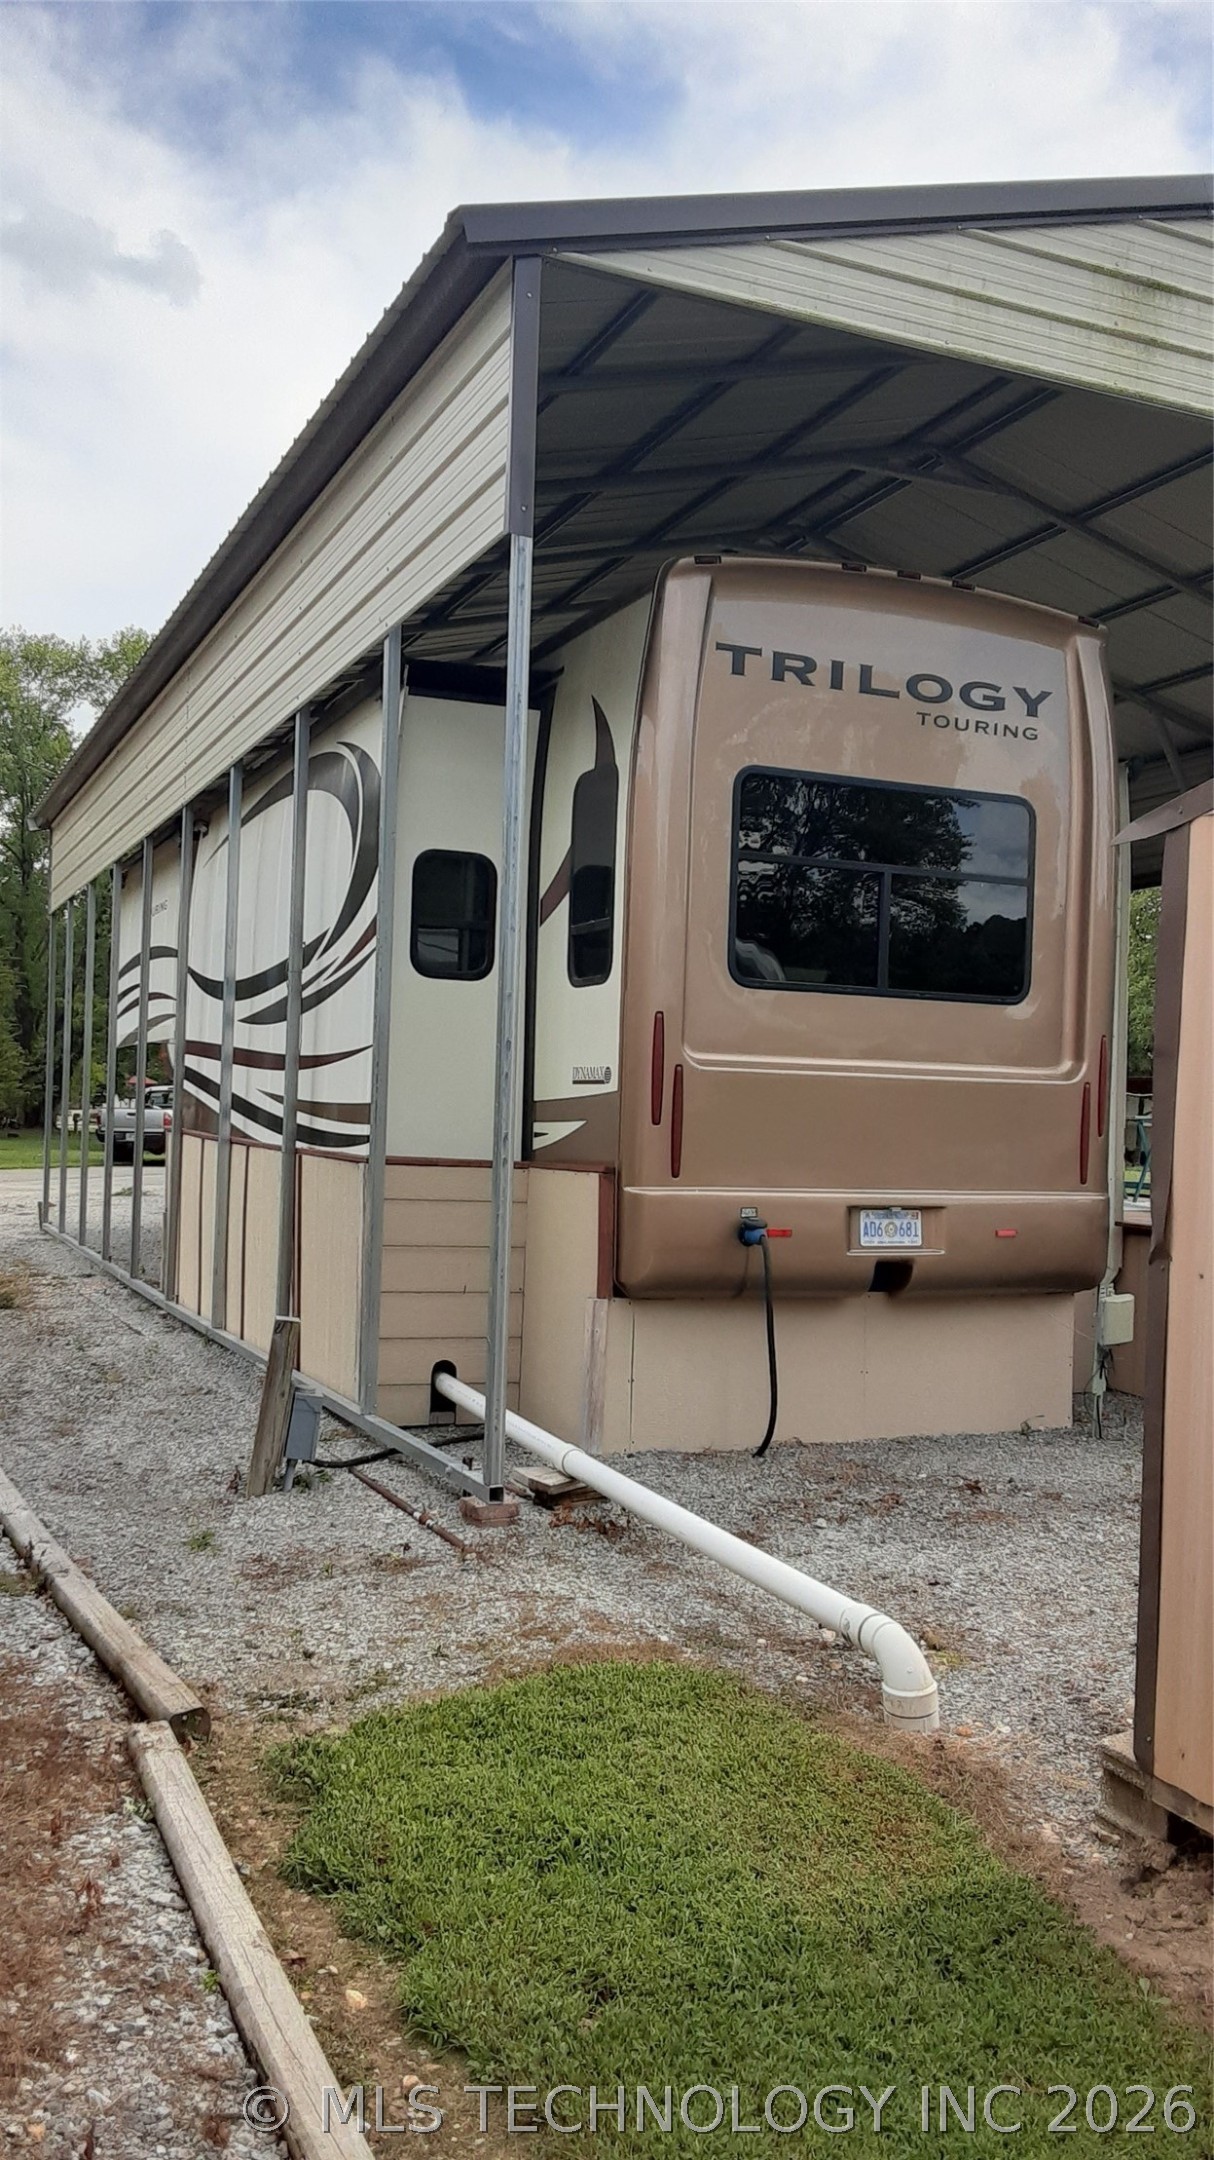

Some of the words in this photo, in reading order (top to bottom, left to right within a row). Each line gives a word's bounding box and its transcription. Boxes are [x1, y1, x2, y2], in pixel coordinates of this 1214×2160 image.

[715, 641, 1053, 718] TRILOGY
[916, 712, 1039, 741] TOURING
[572, 1066, 605, 1080] DYNAMAX
[899, 1221, 919, 1237] 681
